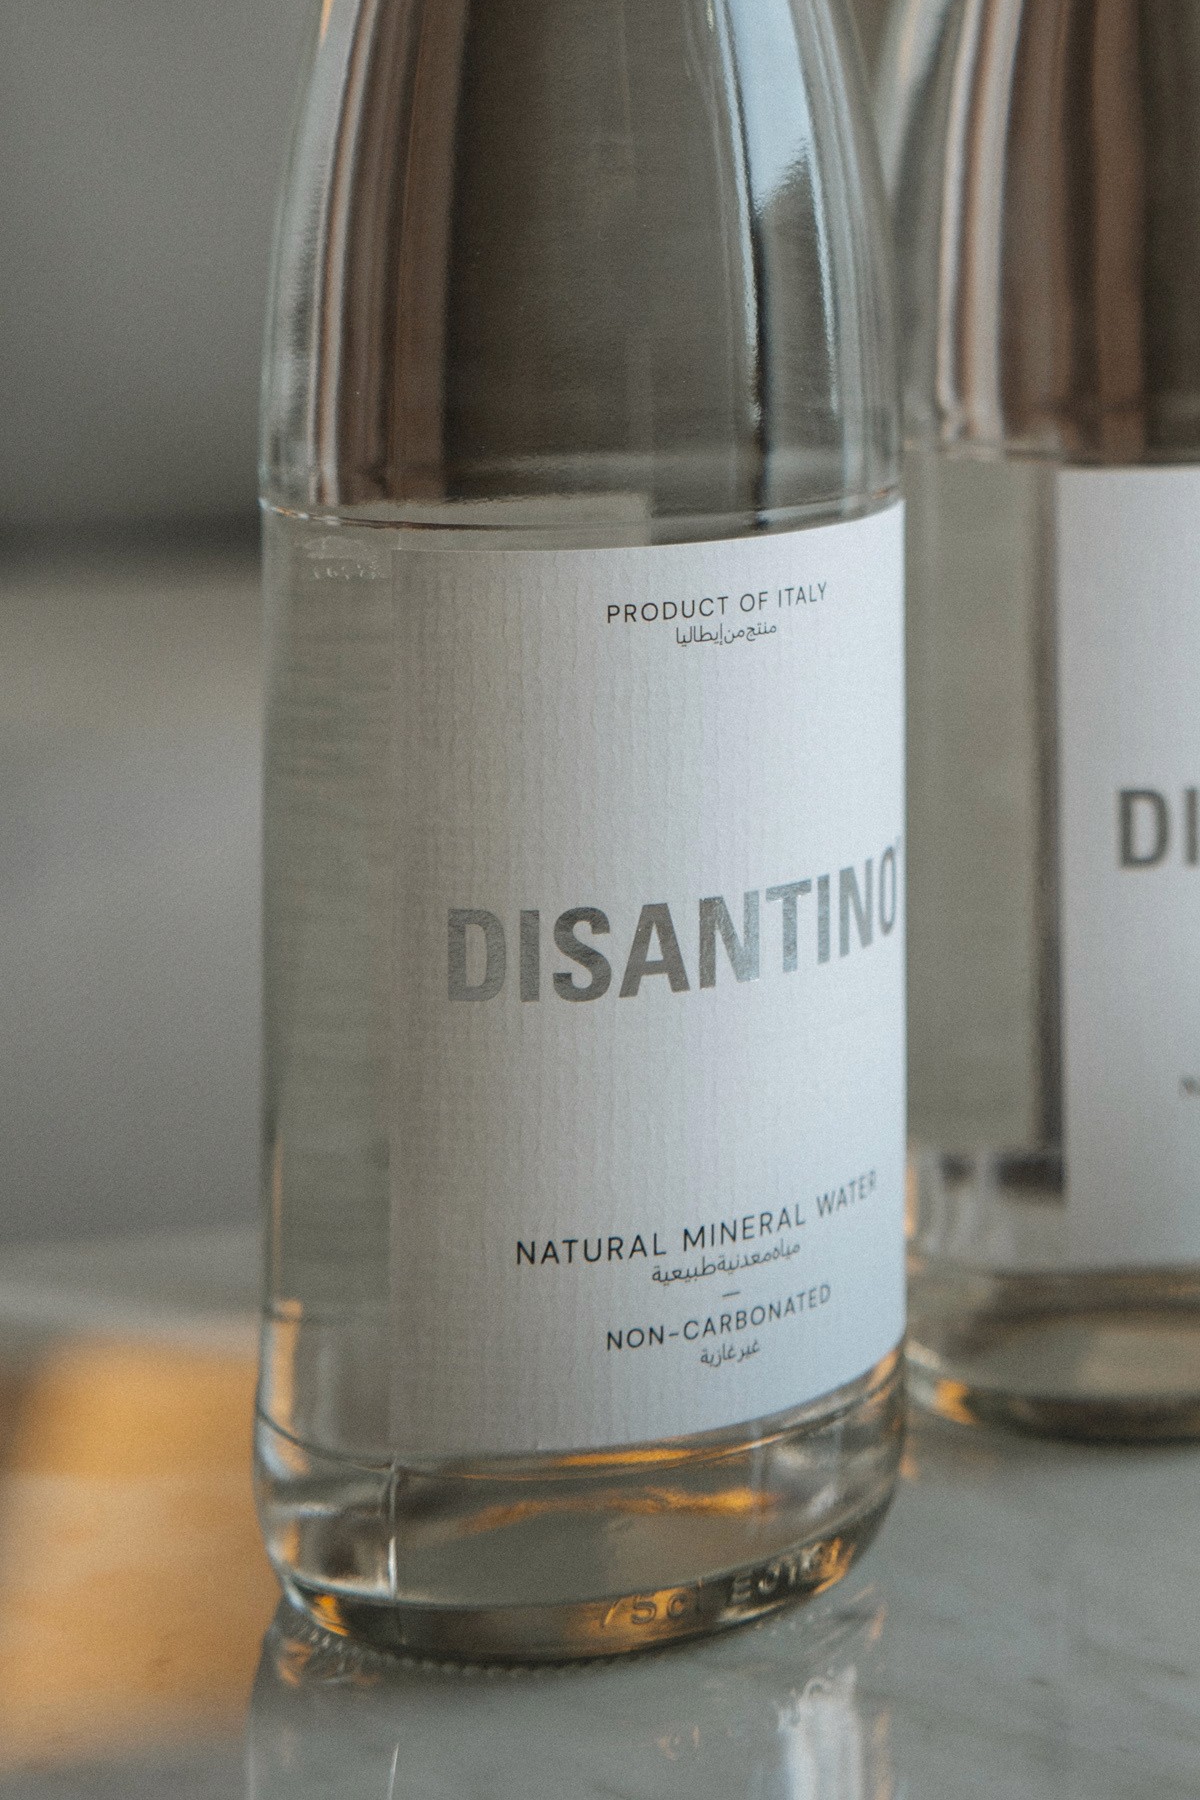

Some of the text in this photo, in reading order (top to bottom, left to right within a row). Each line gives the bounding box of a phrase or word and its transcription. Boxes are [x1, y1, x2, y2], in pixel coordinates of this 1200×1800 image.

[606, 581, 828, 624] PRODUCT OF ITALY
[446, 845, 897, 1003] DISANTINO
[516, 1168, 877, 1266] NATURAL MINERAL WATER
[606, 1283, 832, 1351] NON-CARBONATED
